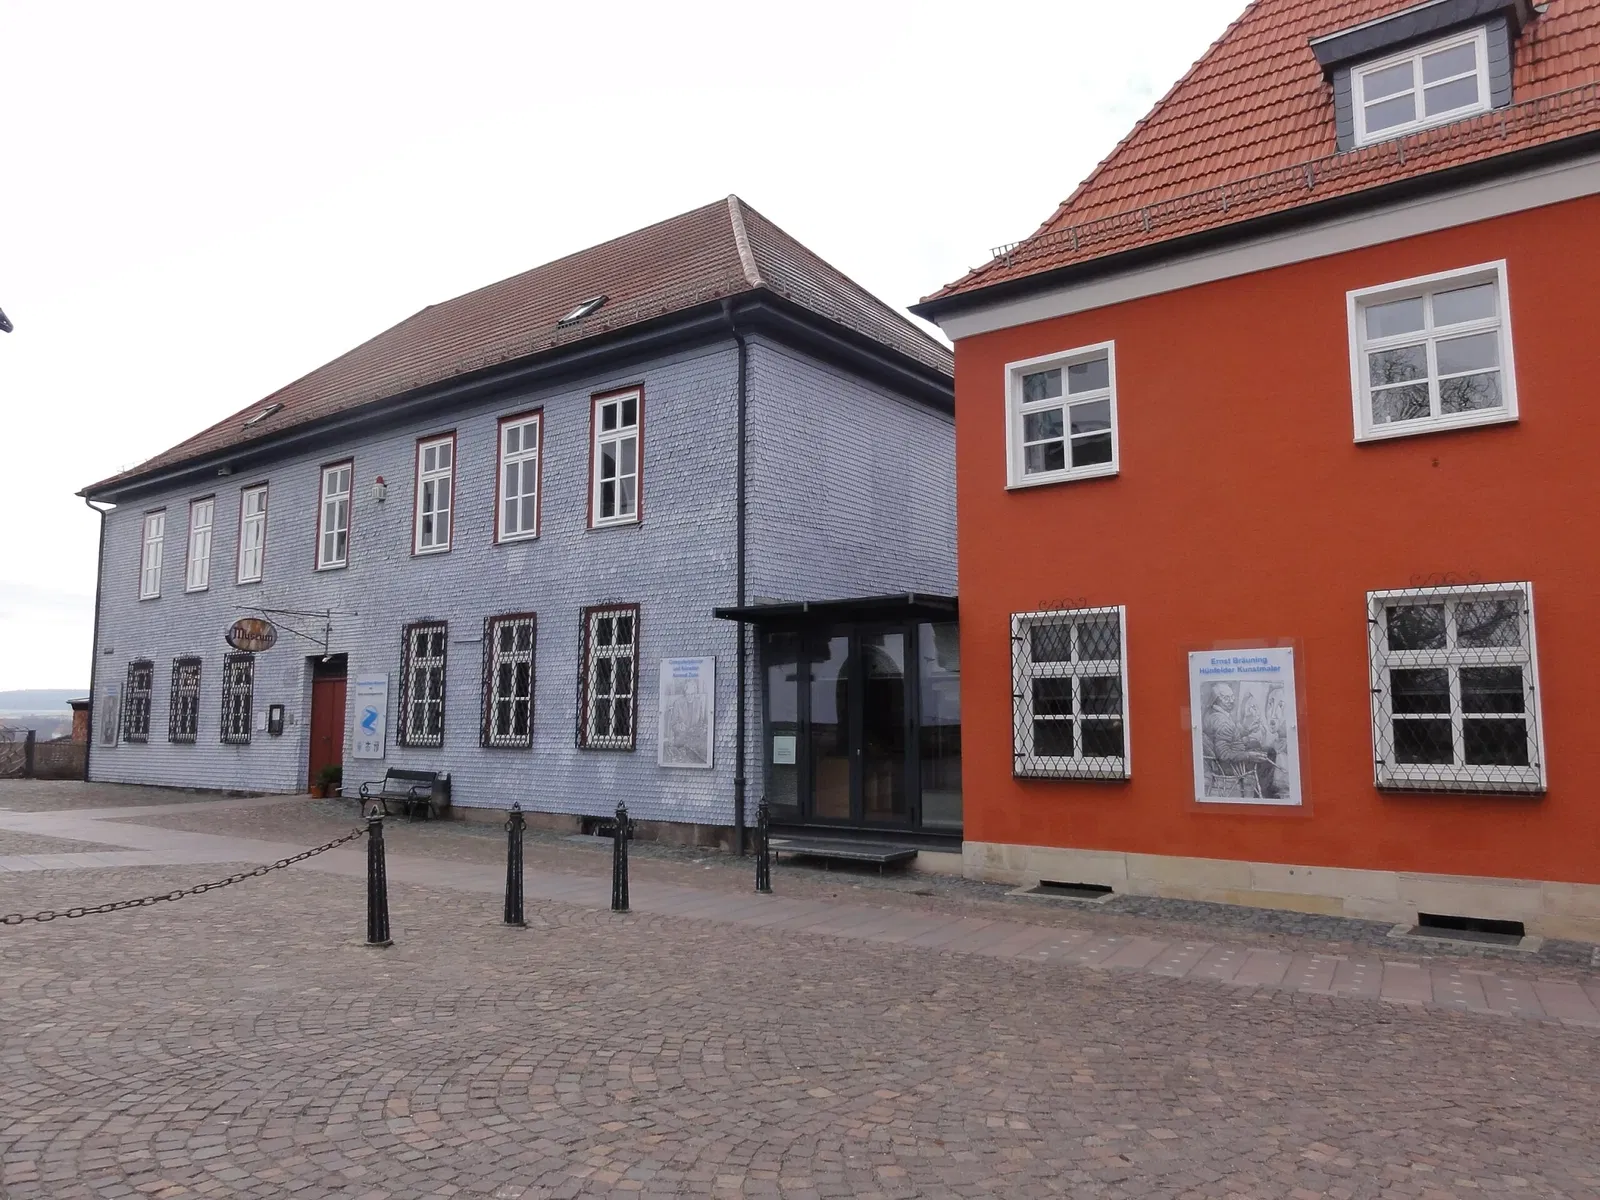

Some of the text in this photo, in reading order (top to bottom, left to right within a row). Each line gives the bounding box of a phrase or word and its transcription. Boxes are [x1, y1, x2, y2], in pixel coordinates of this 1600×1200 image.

[233, 626, 273, 641] Museum
[1211, 656, 1268, 665] Ernst Bräuning
[1199, 665, 1281, 675] Hünfelder Kunstmaler
